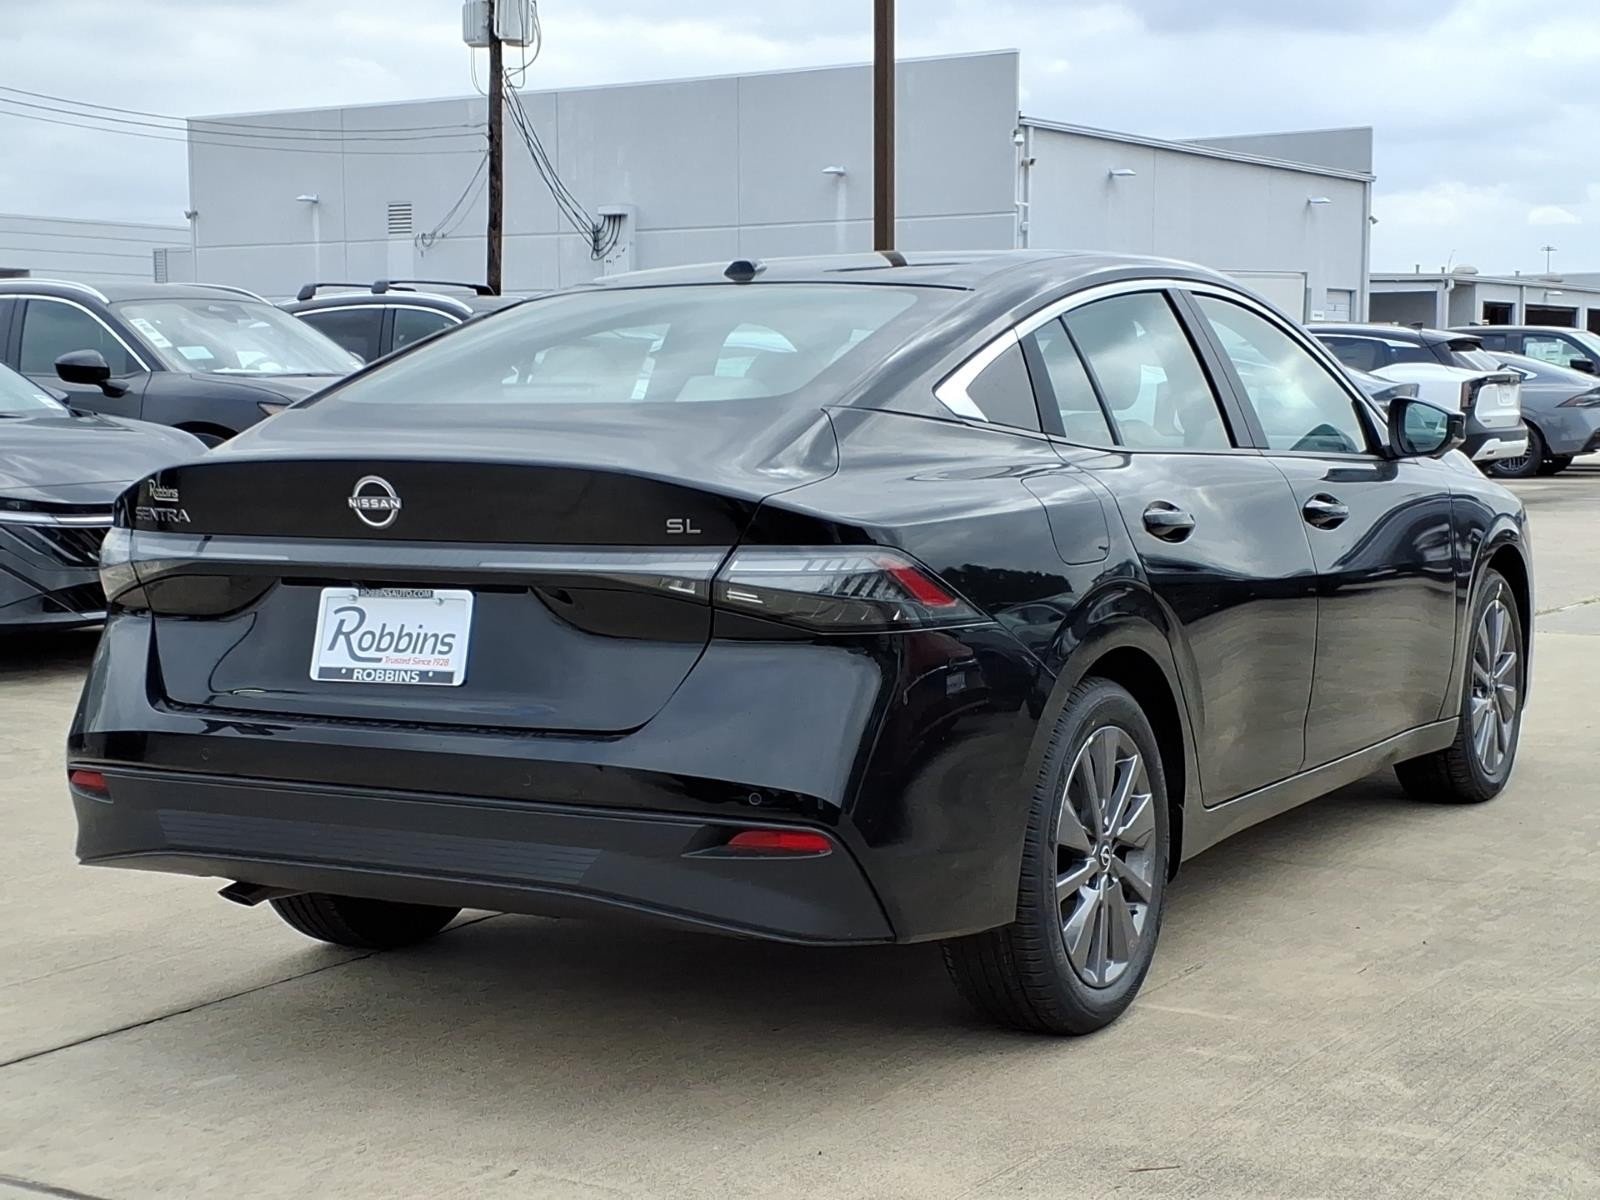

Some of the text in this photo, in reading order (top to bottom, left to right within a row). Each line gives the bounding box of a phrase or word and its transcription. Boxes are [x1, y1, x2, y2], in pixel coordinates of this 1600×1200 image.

[148, 479, 179, 502] Robbins
[348, 497, 401, 509] NISSAN
[136, 506, 191, 522] SENTRA
[666, 518, 701, 533] SL
[327, 606, 456, 663] Robbins
[384, 656, 450, 667] Trusted Since 1928
[353, 669, 420, 683] ROBBINS
